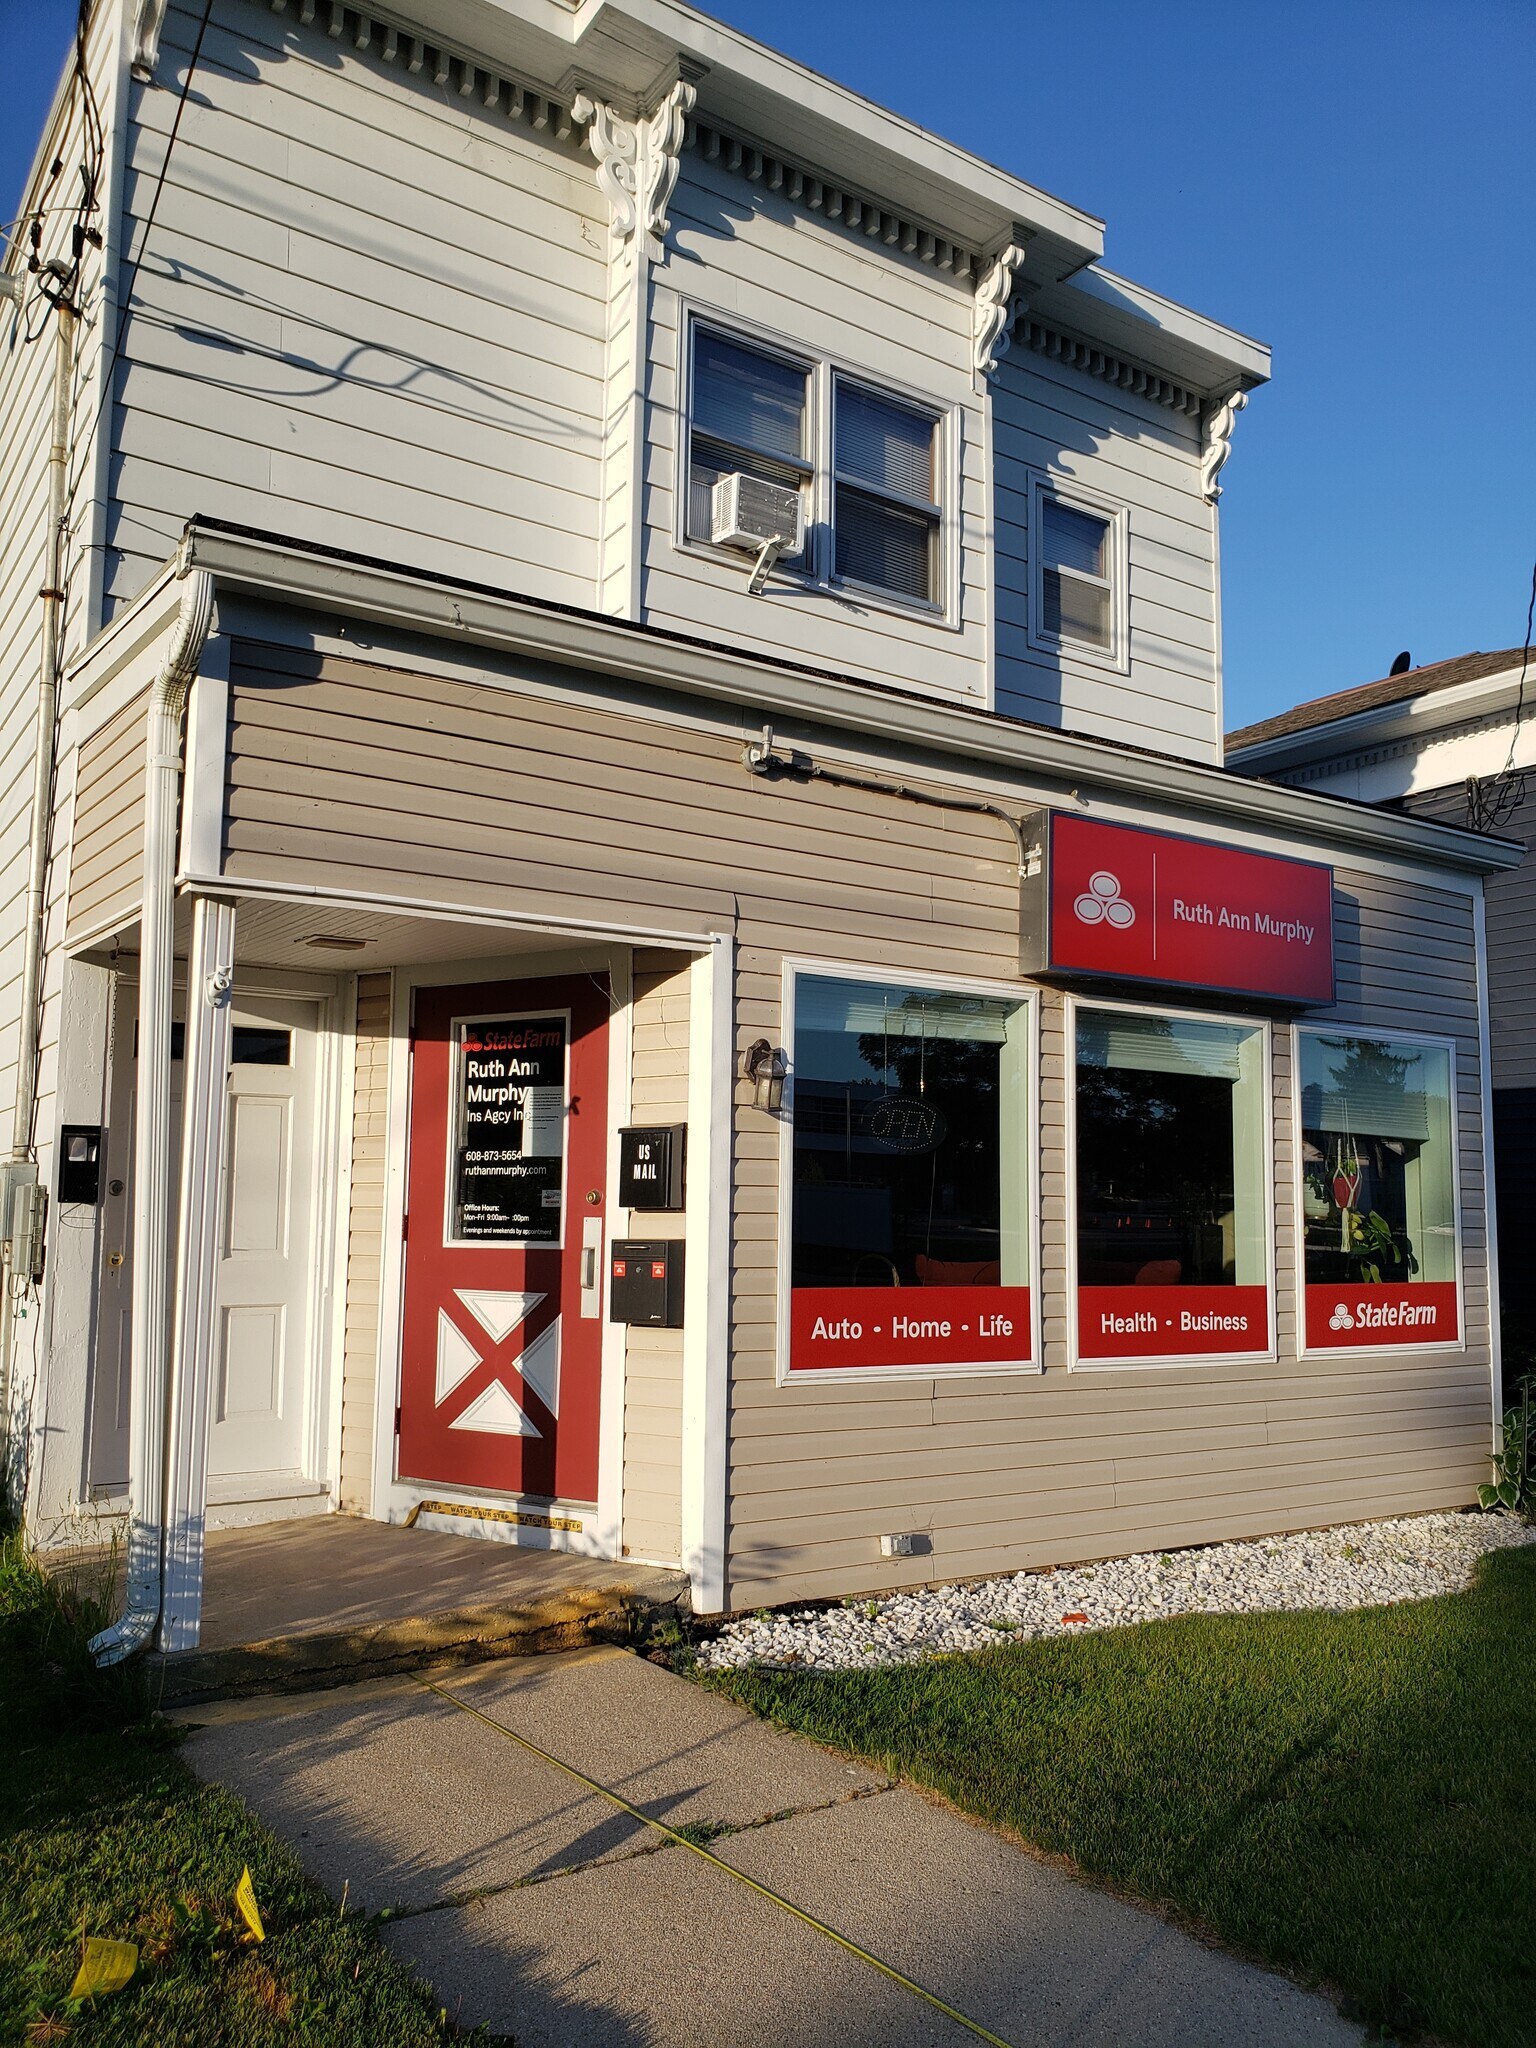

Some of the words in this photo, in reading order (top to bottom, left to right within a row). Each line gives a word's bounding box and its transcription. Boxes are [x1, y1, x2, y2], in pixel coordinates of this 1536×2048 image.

[1172, 898, 1214, 926] Ruth
[1217, 906, 1251, 932] Ann
[1254, 912, 1315, 946] Murphy
[468, 1059, 505, 1079] Ruth
[508, 1058, 540, 1077] Ann
[467, 1083, 529, 1105] Murphy
[467, 1109, 482, 1122] Ins
[484, 1108, 511, 1124] Agcy
[870, 1108, 938, 1139] OPEN
[465, 1150, 522, 1162] 608-873-5654
[638, 1144, 651, 1160] US
[465, 1165, 547, 1177] ruthannmurphy.com
[633, 1163, 657, 1180] MAIL
[464, 1204, 481, 1212] Office
[481, 1204, 500, 1212] Hours:
[463, 1226, 483, 1235] Evenings
[492, 1227, 516, 1235] weekends
[516, 1227, 522, 1236] by
[522, 1228, 552, 1236] appointment
[810, 1316, 864, 1340] Auto
[892, 1316, 952, 1339] Home
[978, 1313, 1014, 1337] Life
[1100, 1312, 1158, 1335] Health
[1180, 1310, 1249, 1332] Business
[450, 1506, 473, 1515] WATCH
[474, 1510, 492, 1518] YOUR
[519, 1516, 542, 1524] WATCH
[543, 1519, 563, 1527] YOUR
[563, 1521, 581, 1529] STEP
